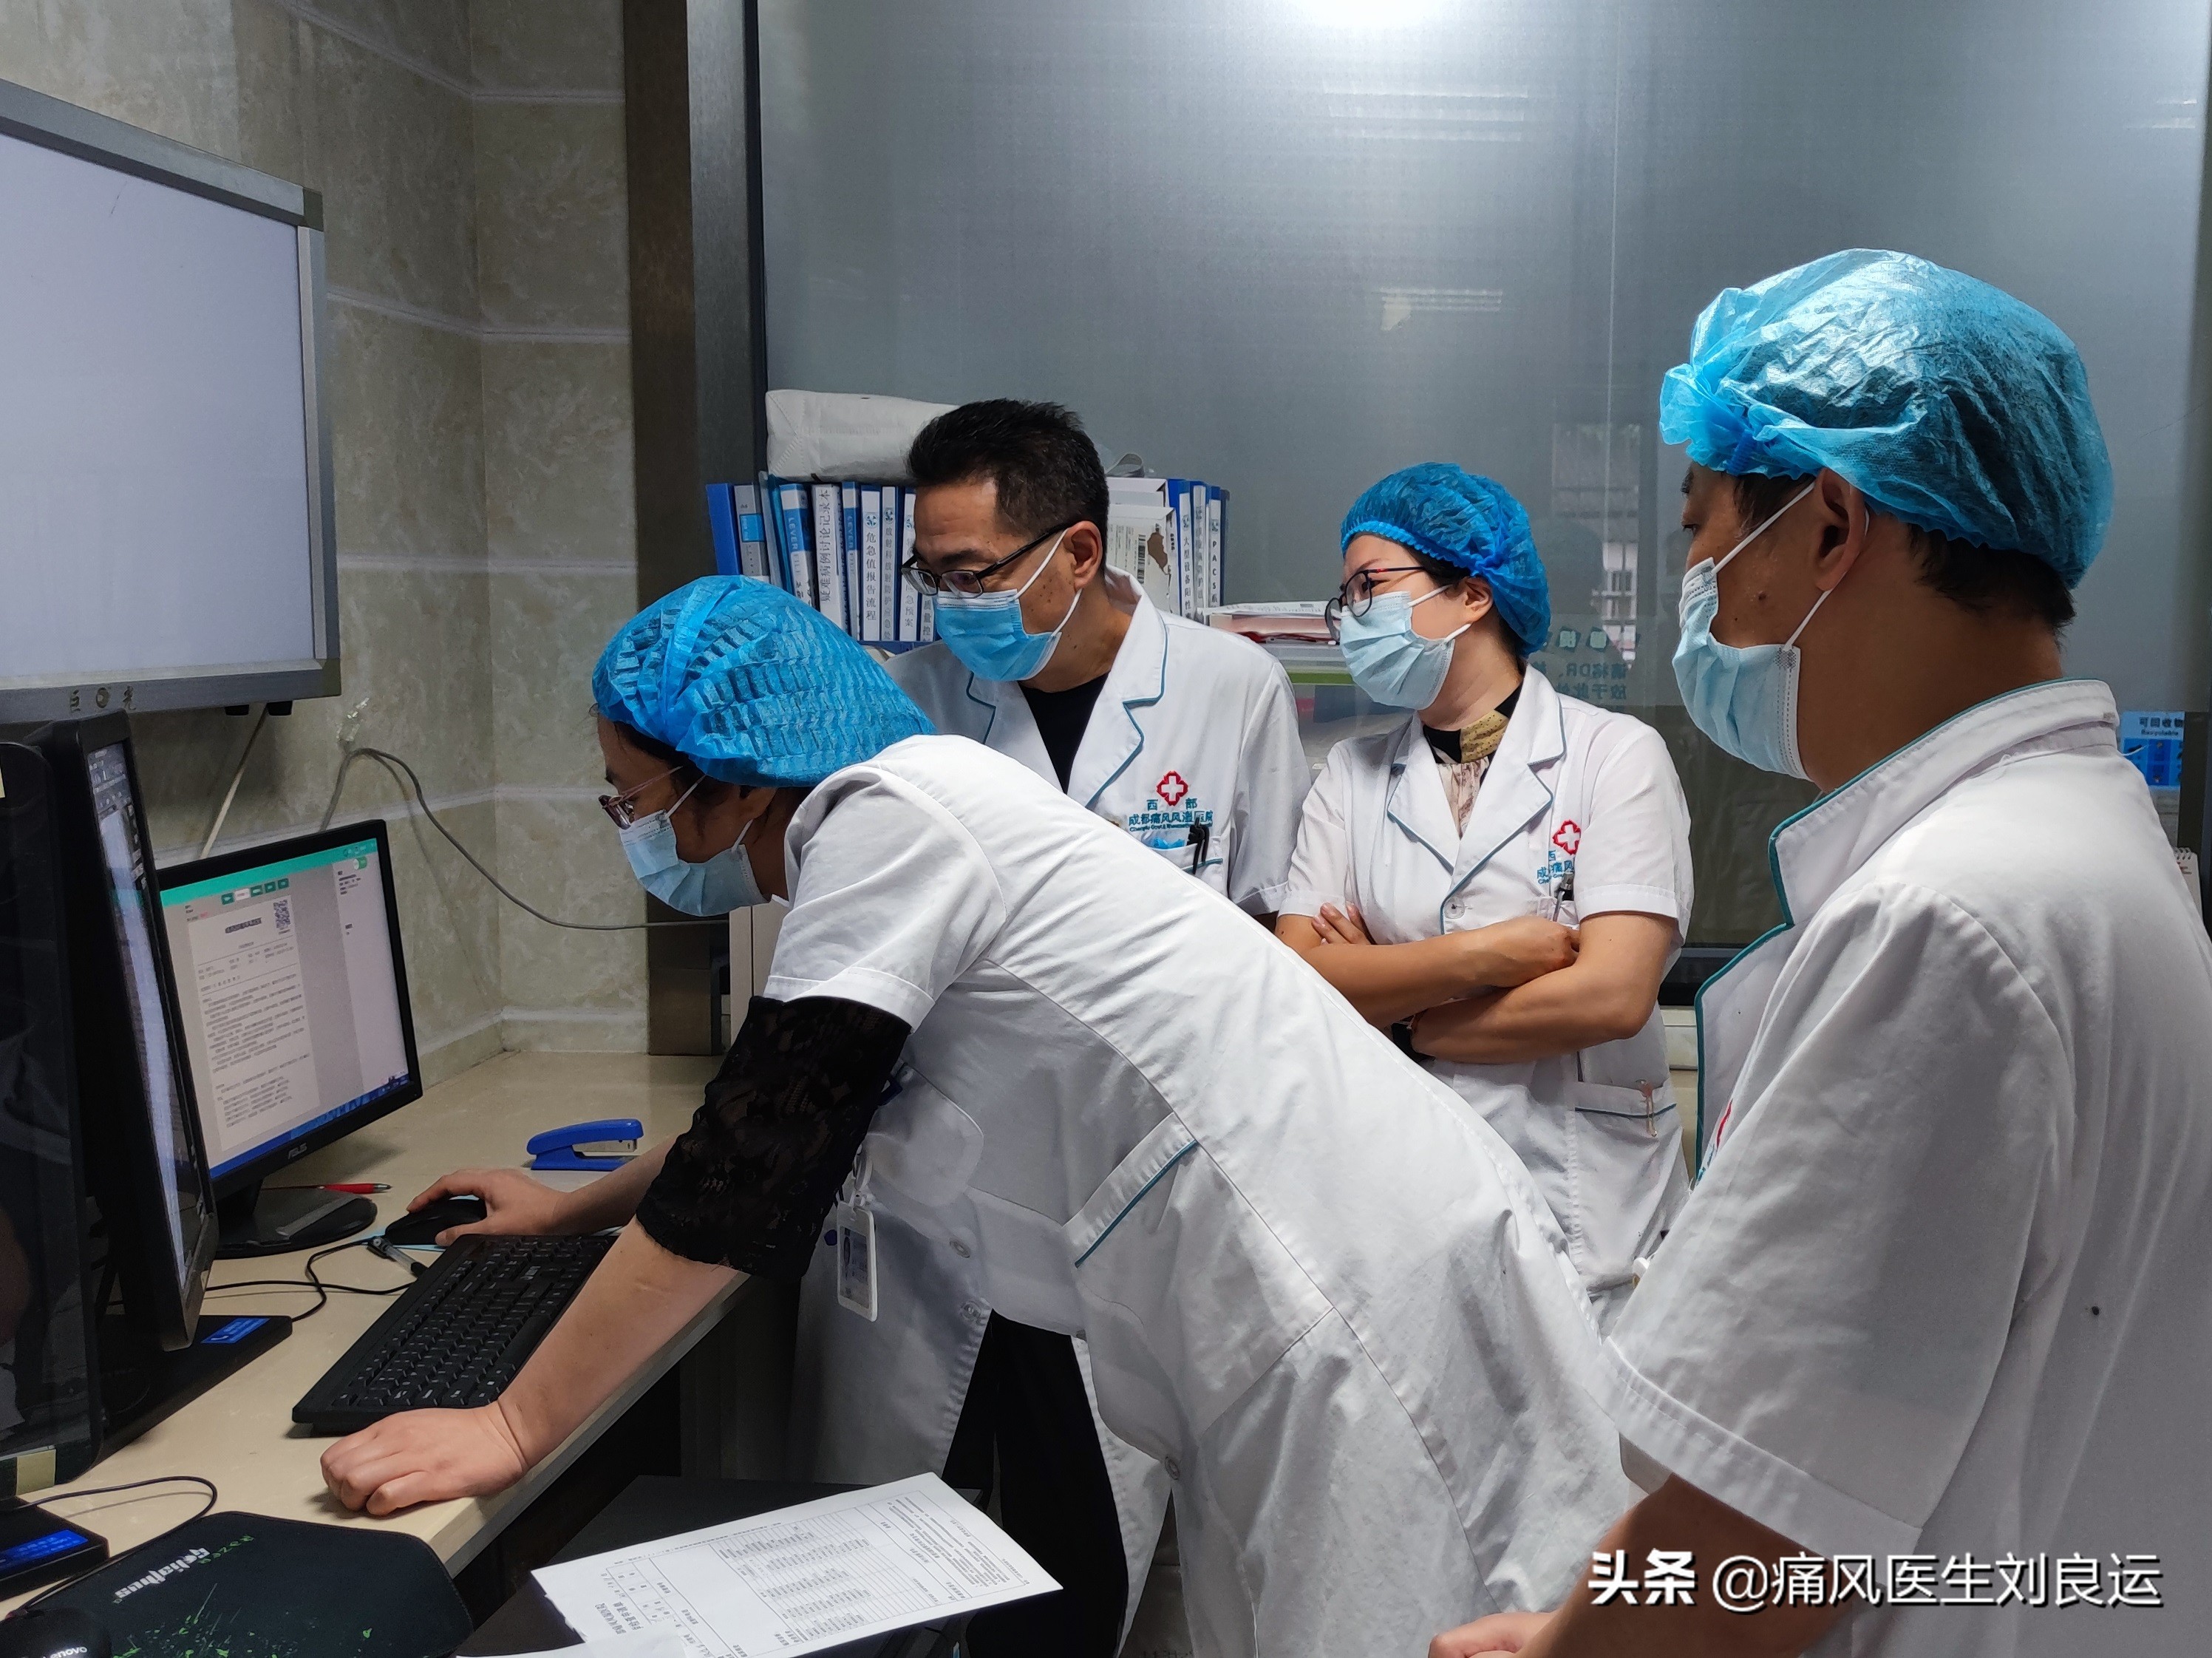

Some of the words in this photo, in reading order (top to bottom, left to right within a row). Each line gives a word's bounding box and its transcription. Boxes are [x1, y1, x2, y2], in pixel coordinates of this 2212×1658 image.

[788, 517, 798, 550] LEVER
[819, 489, 831, 602] 疑难病例讨论记录本
[865, 531, 877, 621] 危急值报告流程
[922, 599, 932, 642] 质量控
